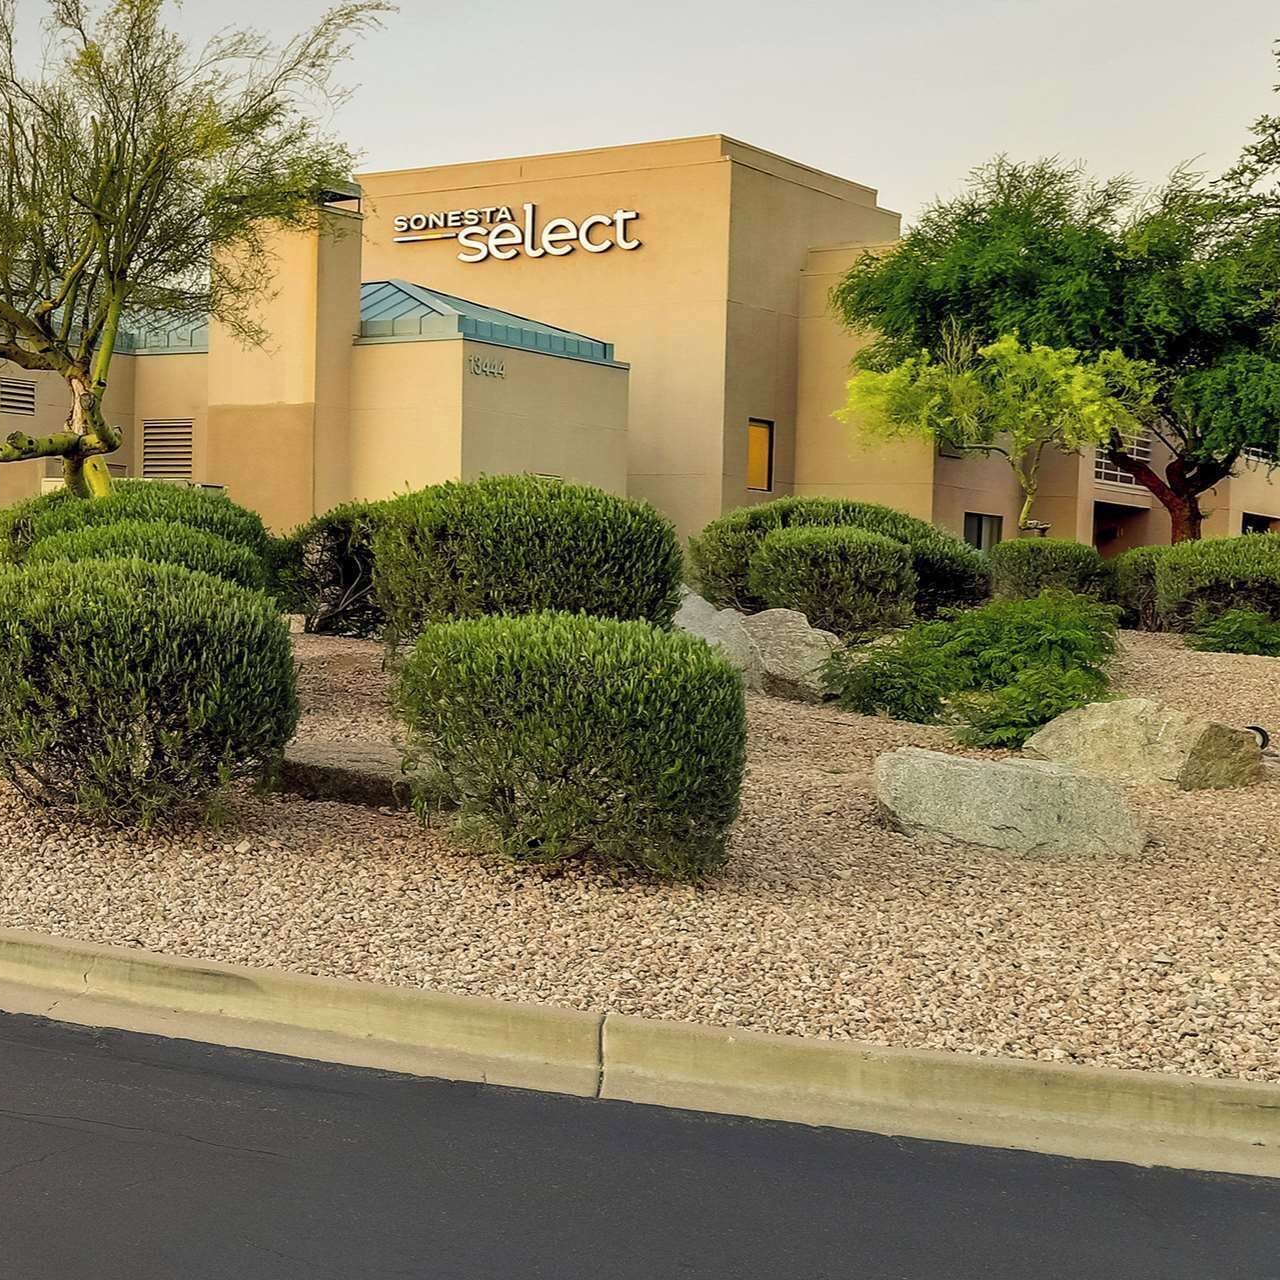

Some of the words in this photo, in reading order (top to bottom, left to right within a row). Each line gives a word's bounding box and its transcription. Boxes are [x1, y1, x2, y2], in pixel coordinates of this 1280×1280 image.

[393, 206, 513, 232] SONESTA
[457, 203, 641, 263] select
[468, 355, 505, 379] 13444
